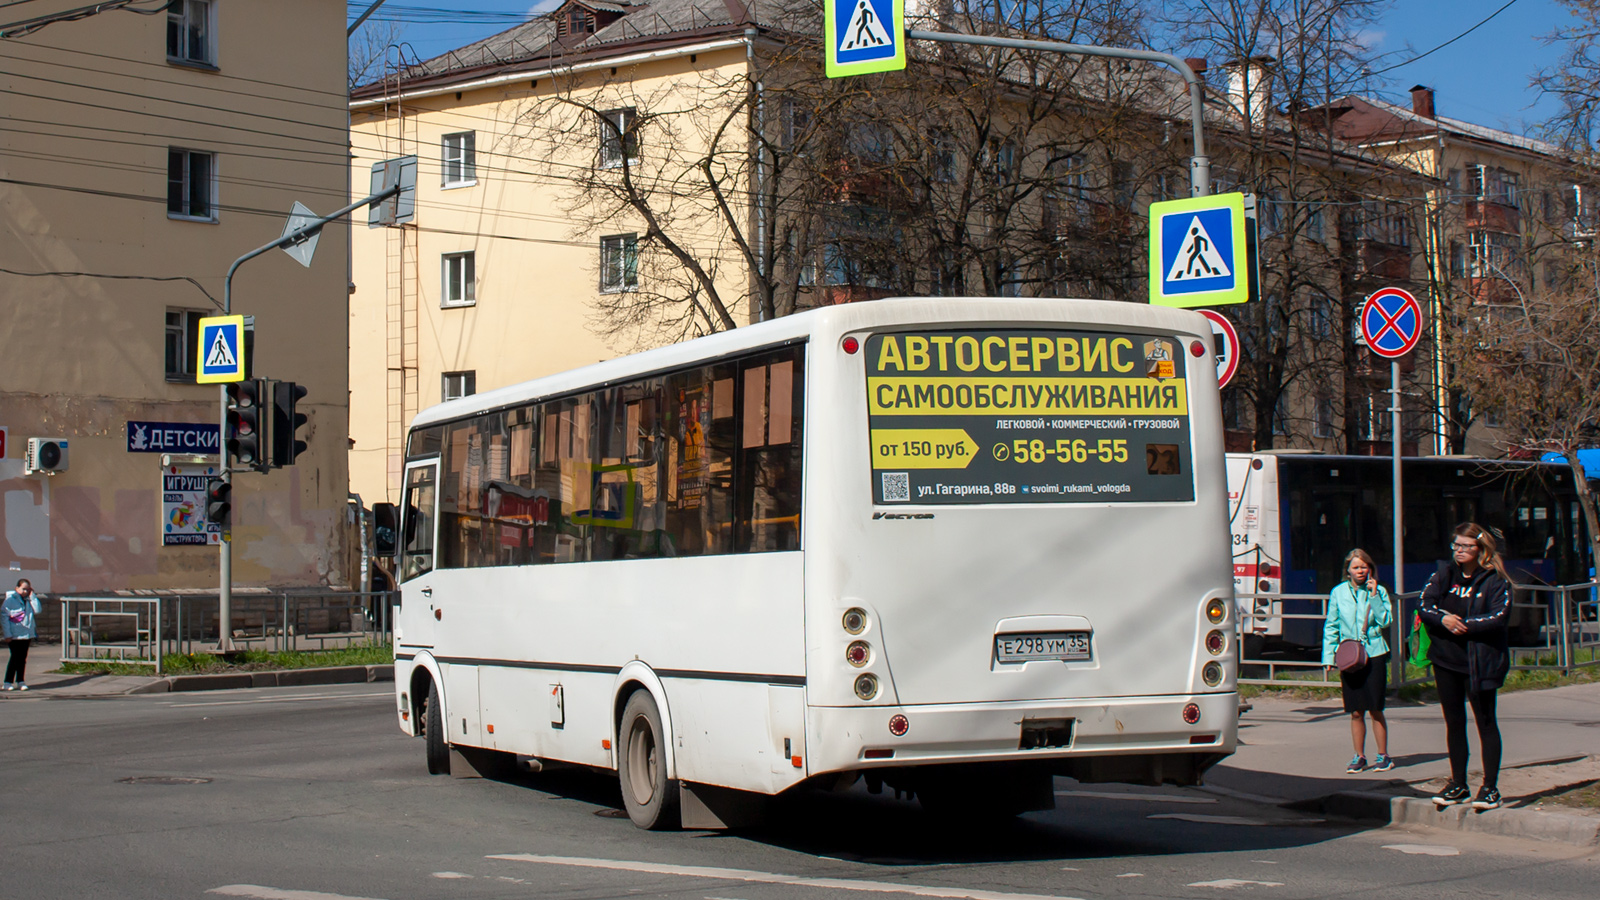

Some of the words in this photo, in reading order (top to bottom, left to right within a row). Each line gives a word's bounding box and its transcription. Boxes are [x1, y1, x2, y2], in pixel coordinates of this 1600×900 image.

[877, 336, 1134, 373] АВТОСЕРВИС
[876, 384, 1178, 409] САМООБСЛУЖИВАНИЯ
[996, 418, 1045, 429] ЛЕГКОВОЙ
[1051, 418, 1127, 429] КОММЕРЧЕСКИЙ
[1133, 418, 1180, 429] ГРУЗОВОЙ
[879, 444, 899, 457] от
[902, 441, 931, 456] 150
[936, 441, 970, 459] руб.
[1013, 439, 1129, 463] 58-56-55
[167, 476, 208, 491] ИГРУШ
[917, 485, 935, 497] ул.
[936, 484, 993, 497] Гагарина,
[994, 482, 1016, 494] 88в
[1031, 484, 1131, 495] svoimi_rukami_vologda
[166, 534, 205, 543] КОНСТРУКТОРЫ
[1069, 635, 1084, 647] 35
